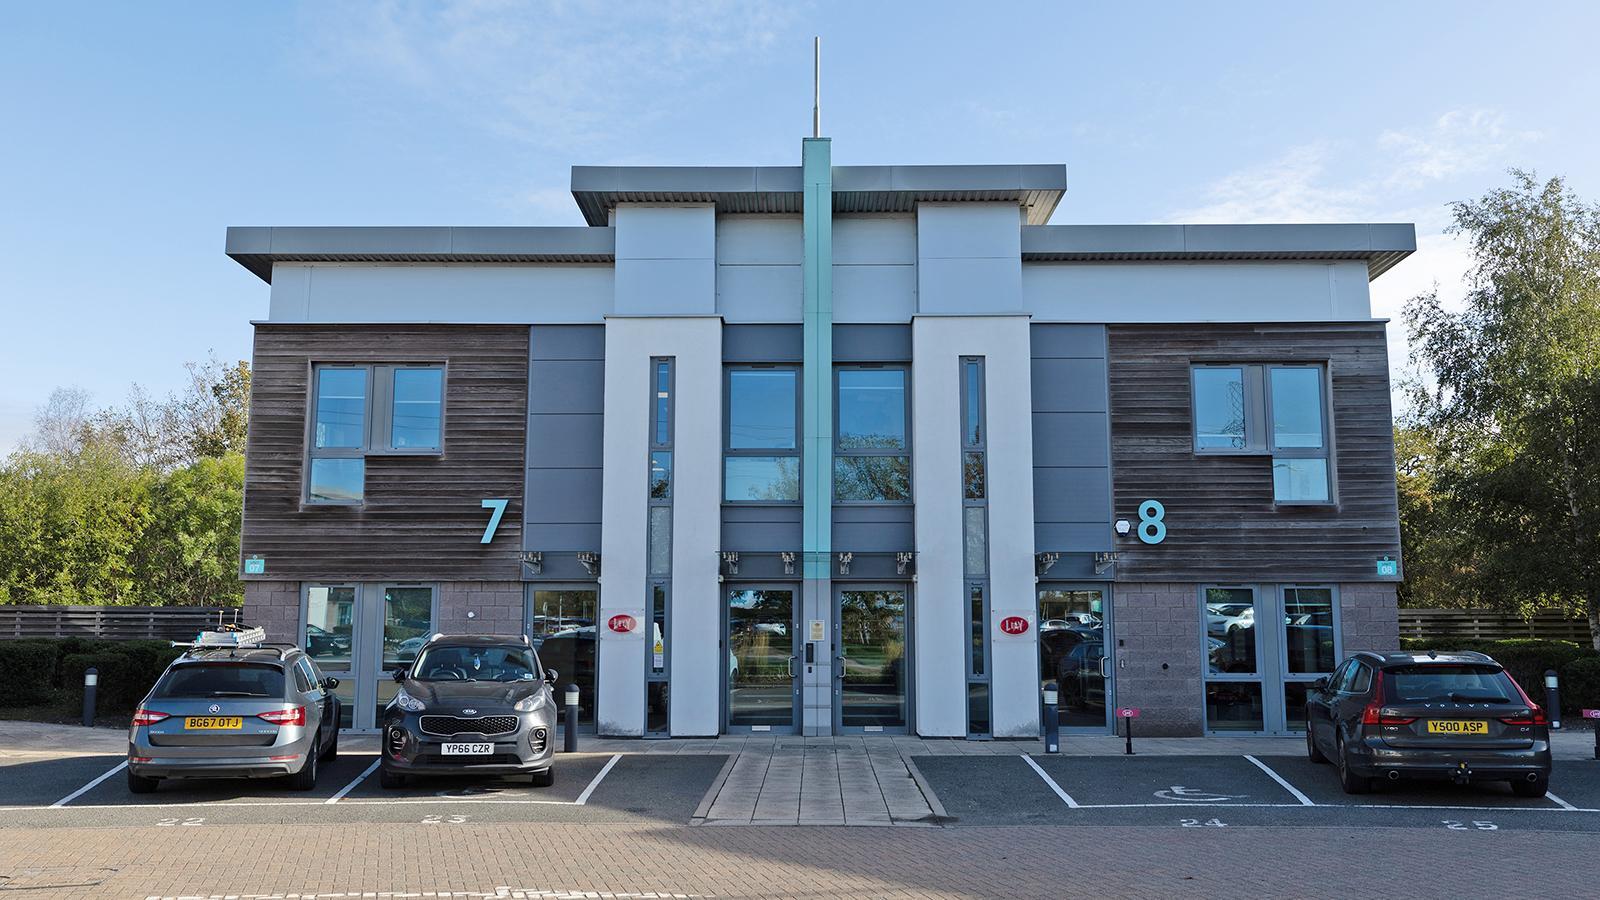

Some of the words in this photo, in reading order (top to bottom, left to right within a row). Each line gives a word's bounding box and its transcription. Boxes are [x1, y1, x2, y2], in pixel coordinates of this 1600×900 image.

[480, 499, 509, 543] 7
[1138, 499, 1166, 545] 8
[249, 564, 260, 572] 07
[190, 718, 217, 728] BG67
[218, 718, 239, 728] OTJ
[1432, 721, 1460, 732] Y500
[1462, 722, 1483, 732] ASP
[446, 744, 470, 753] YP66
[472, 744, 490, 753] CZR
[155, 817, 206, 826] 22
[421, 814, 466, 824] 23
[1180, 818, 1228, 828] 24
[1441, 820, 1498, 830] 25
